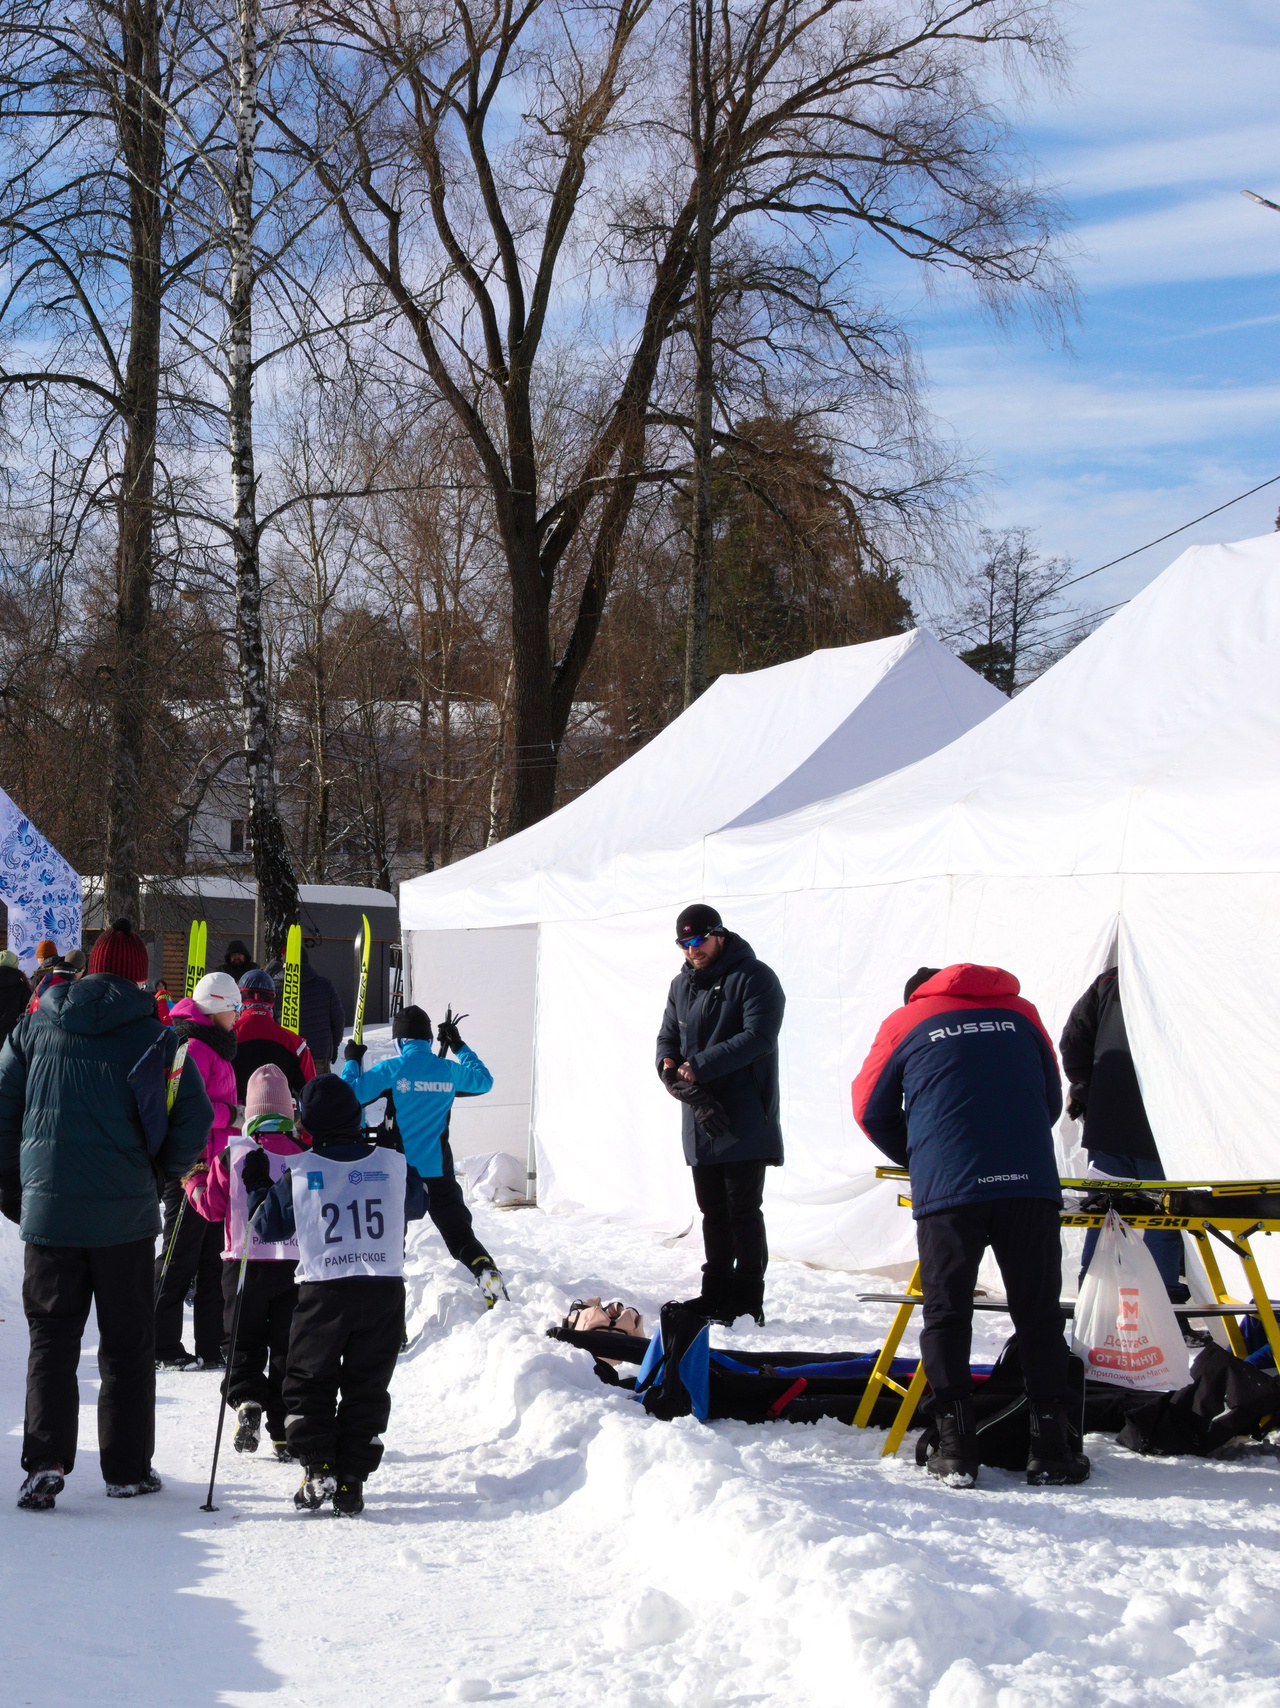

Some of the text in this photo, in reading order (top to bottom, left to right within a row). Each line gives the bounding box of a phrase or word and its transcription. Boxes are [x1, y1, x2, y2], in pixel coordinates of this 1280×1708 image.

[282, 961, 294, 1028] BRADOS
[928, 1021, 1017, 1042] RUSSIA
[413, 1080, 454, 1092] SNOW
[977, 1173, 1029, 1185] NORDSKI
[1081, 1180, 1144, 1189] FISCHER
[321, 1198, 385, 1245] 215
[324, 1252, 387, 1267] РАМЕНСКОЕ
[1096, 1354, 1112, 1364] от
[1116, 1355, 1128, 1366] 15
